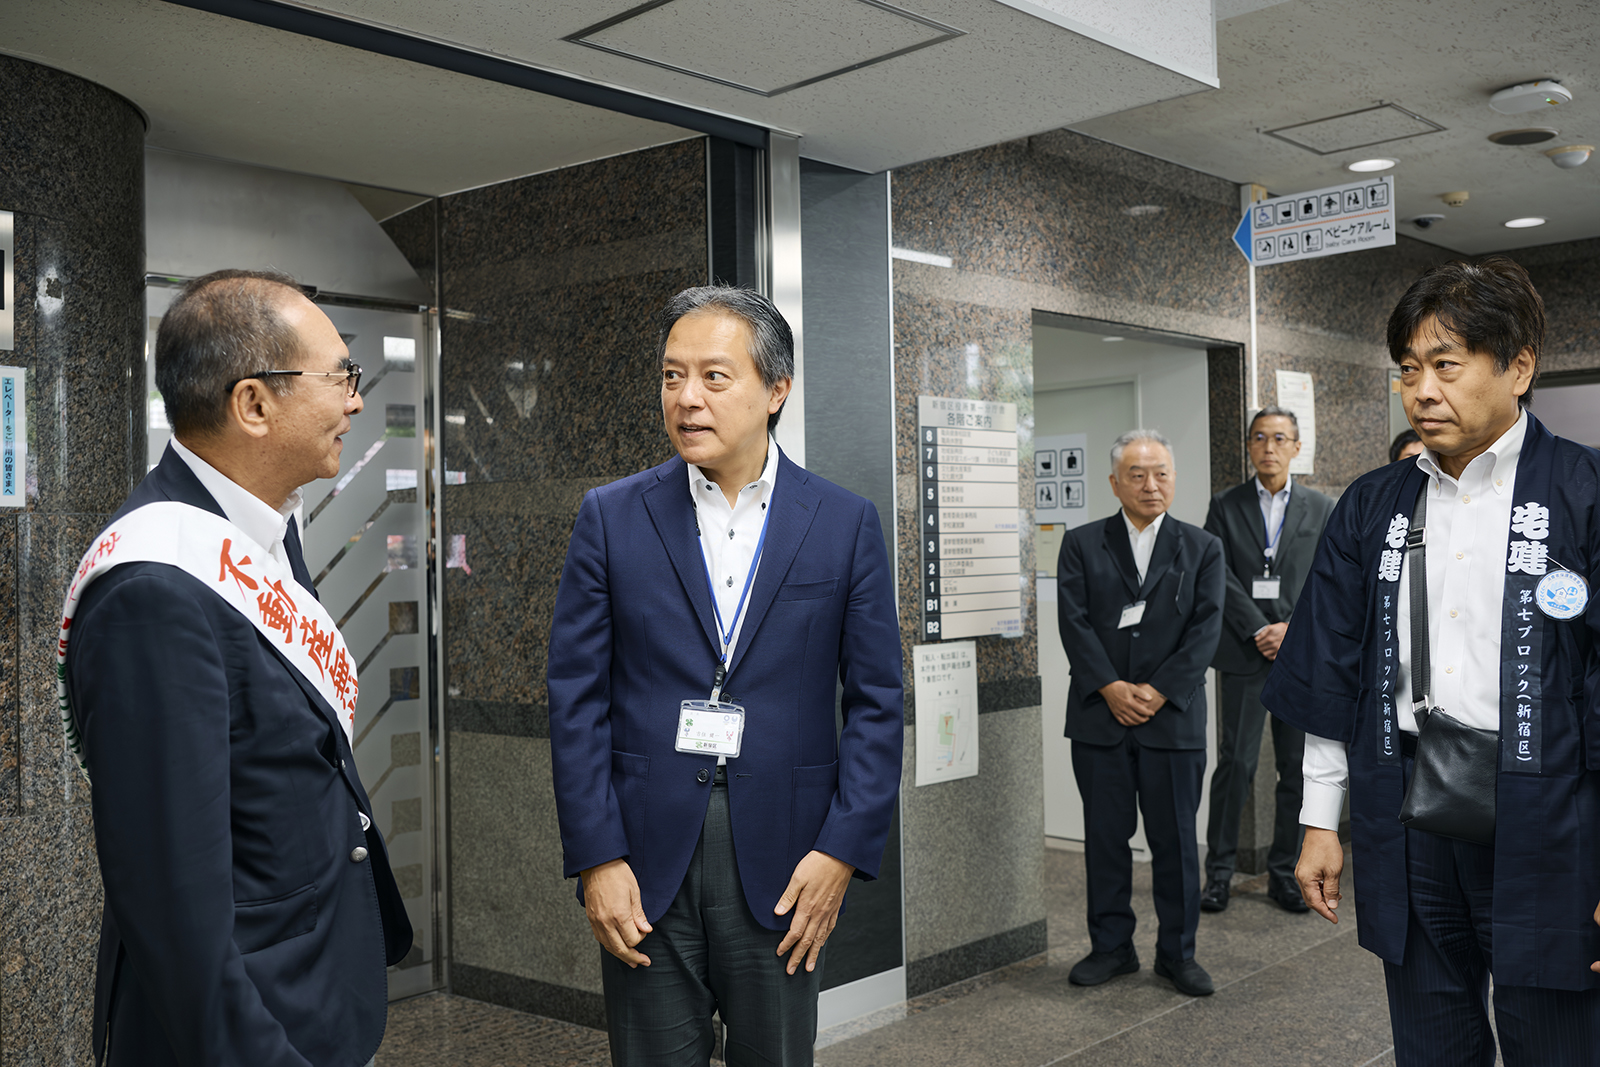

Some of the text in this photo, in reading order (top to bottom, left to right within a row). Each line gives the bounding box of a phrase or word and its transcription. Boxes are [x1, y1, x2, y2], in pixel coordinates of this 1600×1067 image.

[1325, 218, 1390, 239] ベビーケアルーム
[947, 412, 992, 428] 各階ご案内
[926, 430, 933, 442] 8
[926, 447, 933, 460] 7
[926, 466, 934, 478] 6
[927, 488, 934, 500] 5
[927, 514, 934, 526] 4
[1507, 501, 1550, 576] 宅建
[928, 540, 935, 553] 3
[1378, 513, 1410, 583] 宅建
[928, 562, 935, 575] 2
[929, 581, 935, 593] 1
[926, 599, 938, 611] B1
[927, 621, 939, 634] B2
[1516, 589, 1534, 762] 第七ブロック（新宿区）
